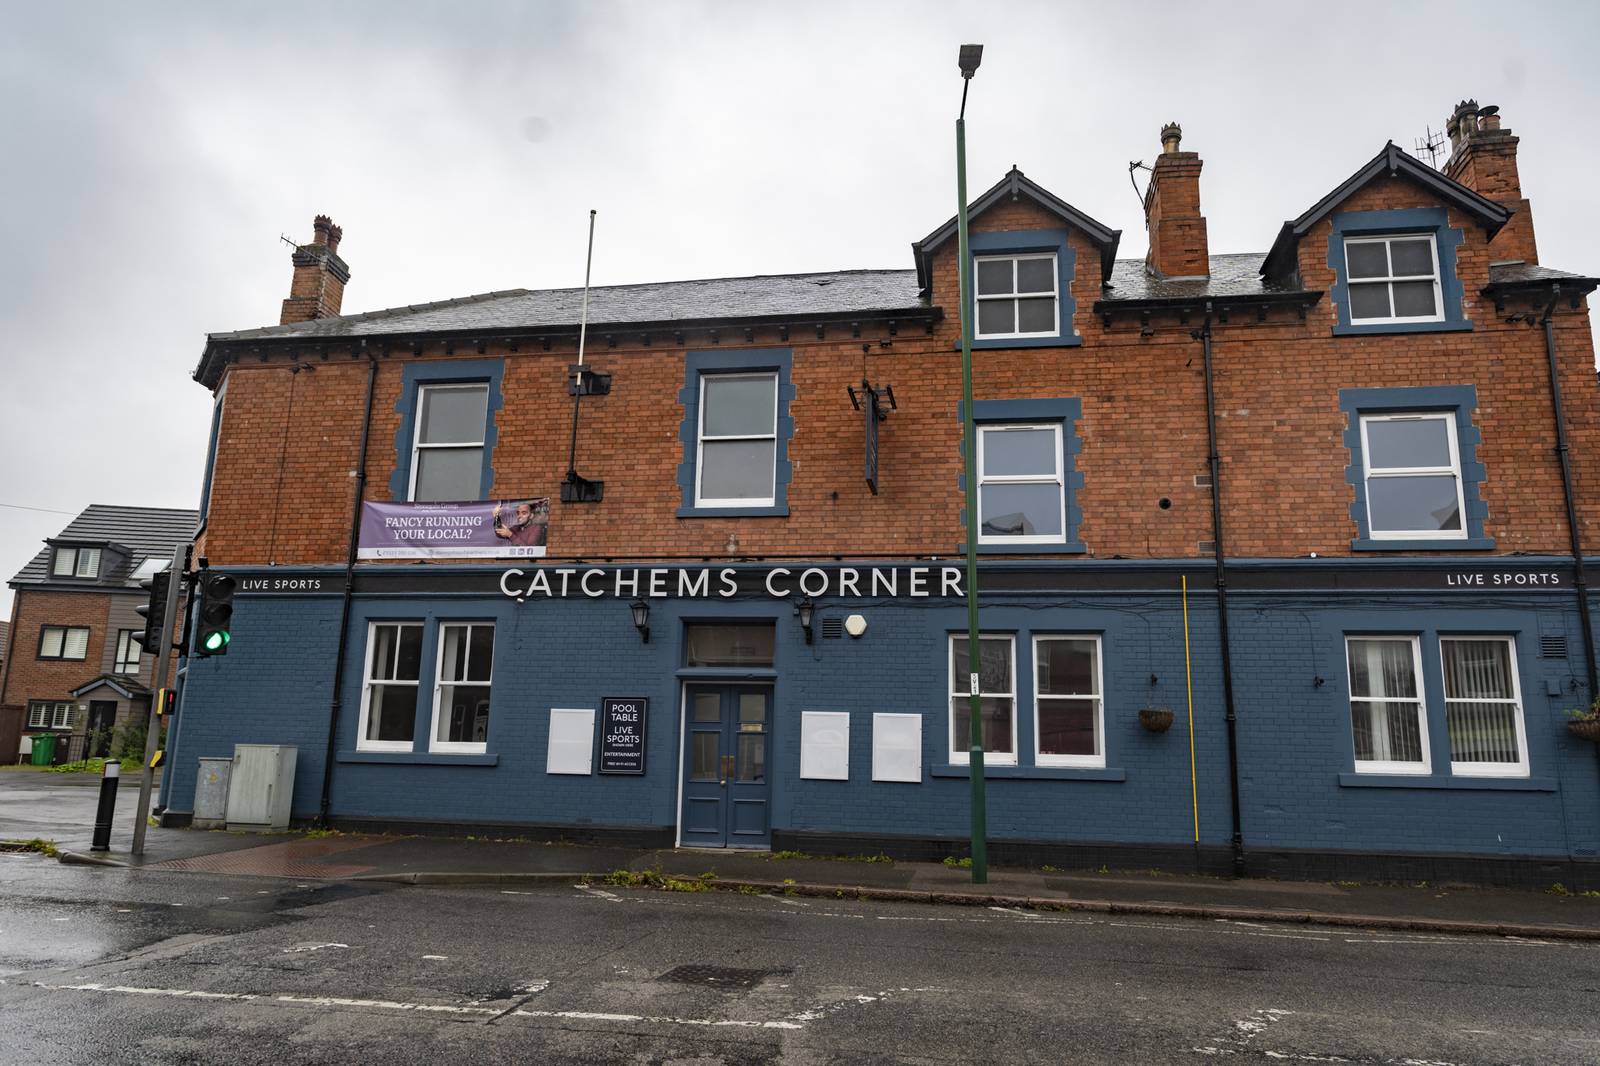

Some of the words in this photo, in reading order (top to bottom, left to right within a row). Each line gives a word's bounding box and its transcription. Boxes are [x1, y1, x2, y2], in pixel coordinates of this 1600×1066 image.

[385, 516, 424, 528] FANCY
[425, 516, 482, 528] RUNNING
[393, 529, 425, 540] YOUR
[427, 529, 473, 540] LOCAL?
[242, 579, 269, 590] LIVE
[274, 579, 321, 590] SPORTS
[500, 568, 738, 598] CATCHEMS
[765, 567, 965, 598] CORNER
[1447, 574, 1485, 585] LIVE
[1493, 573, 1560, 585] SPORTS
[612, 704, 637, 712] POOL
[614, 726, 633, 734] LIVE
